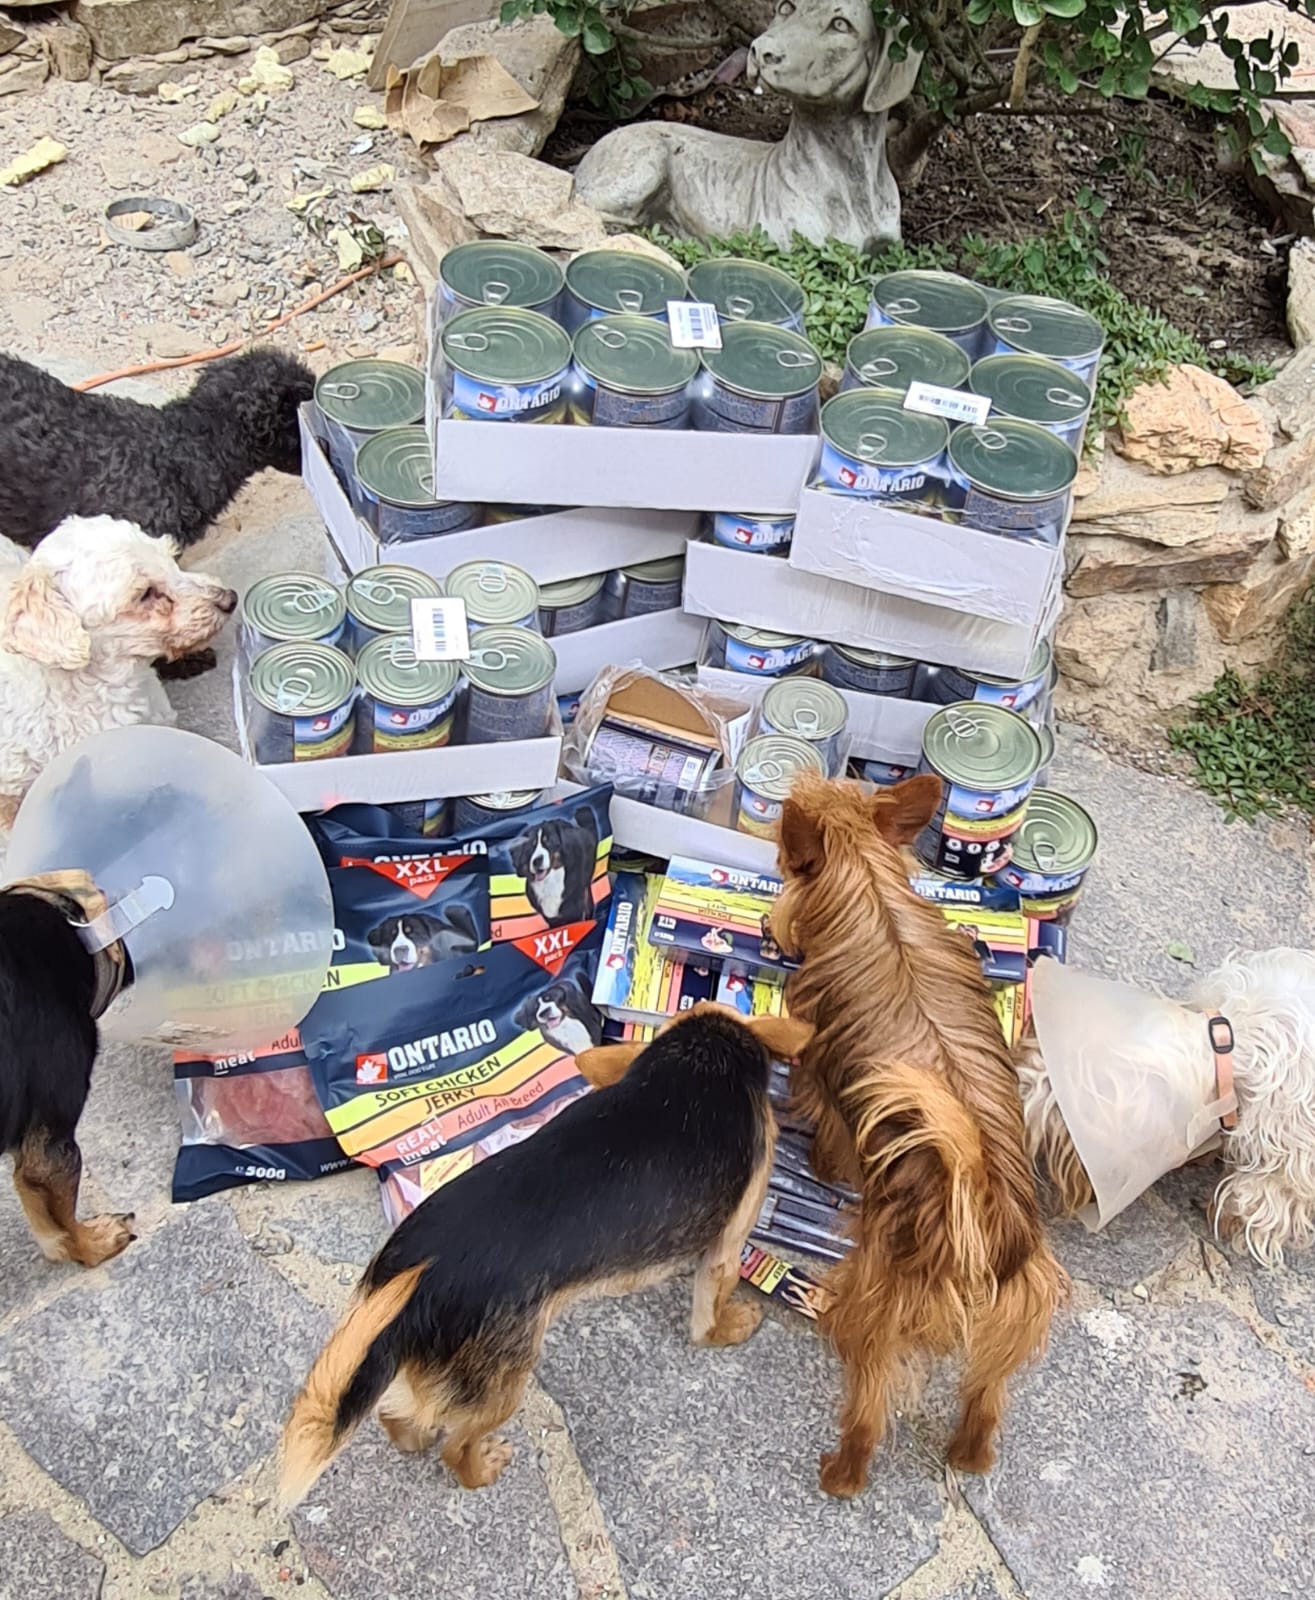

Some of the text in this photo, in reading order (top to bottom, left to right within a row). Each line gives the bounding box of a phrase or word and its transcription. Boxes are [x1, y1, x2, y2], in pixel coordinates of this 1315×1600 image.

[498, 385, 561, 412] ONTARIO
[855, 474, 926, 492] ONTARIO
[394, 859, 449, 879] XXL
[409, 874, 436, 887] pack
[915, 886, 981, 902] ONTARIO
[610, 901, 633, 955] ONTARIO
[534, 929, 574, 958] XXL
[544, 950, 563, 966] pack
[388, 1018, 497, 1072] ONTARIO
[375, 1086, 421, 1107] SOFT
[425, 1056, 502, 1092] CHICKEN
[425, 1087, 477, 1115] JERKY
[457, 1104, 491, 1129] Adult
[494, 1096, 512, 1112] All
[395, 1123, 441, 1154] REAL
[402, 1135, 448, 1163] meat
[245, 1165, 287, 1181] 500g
